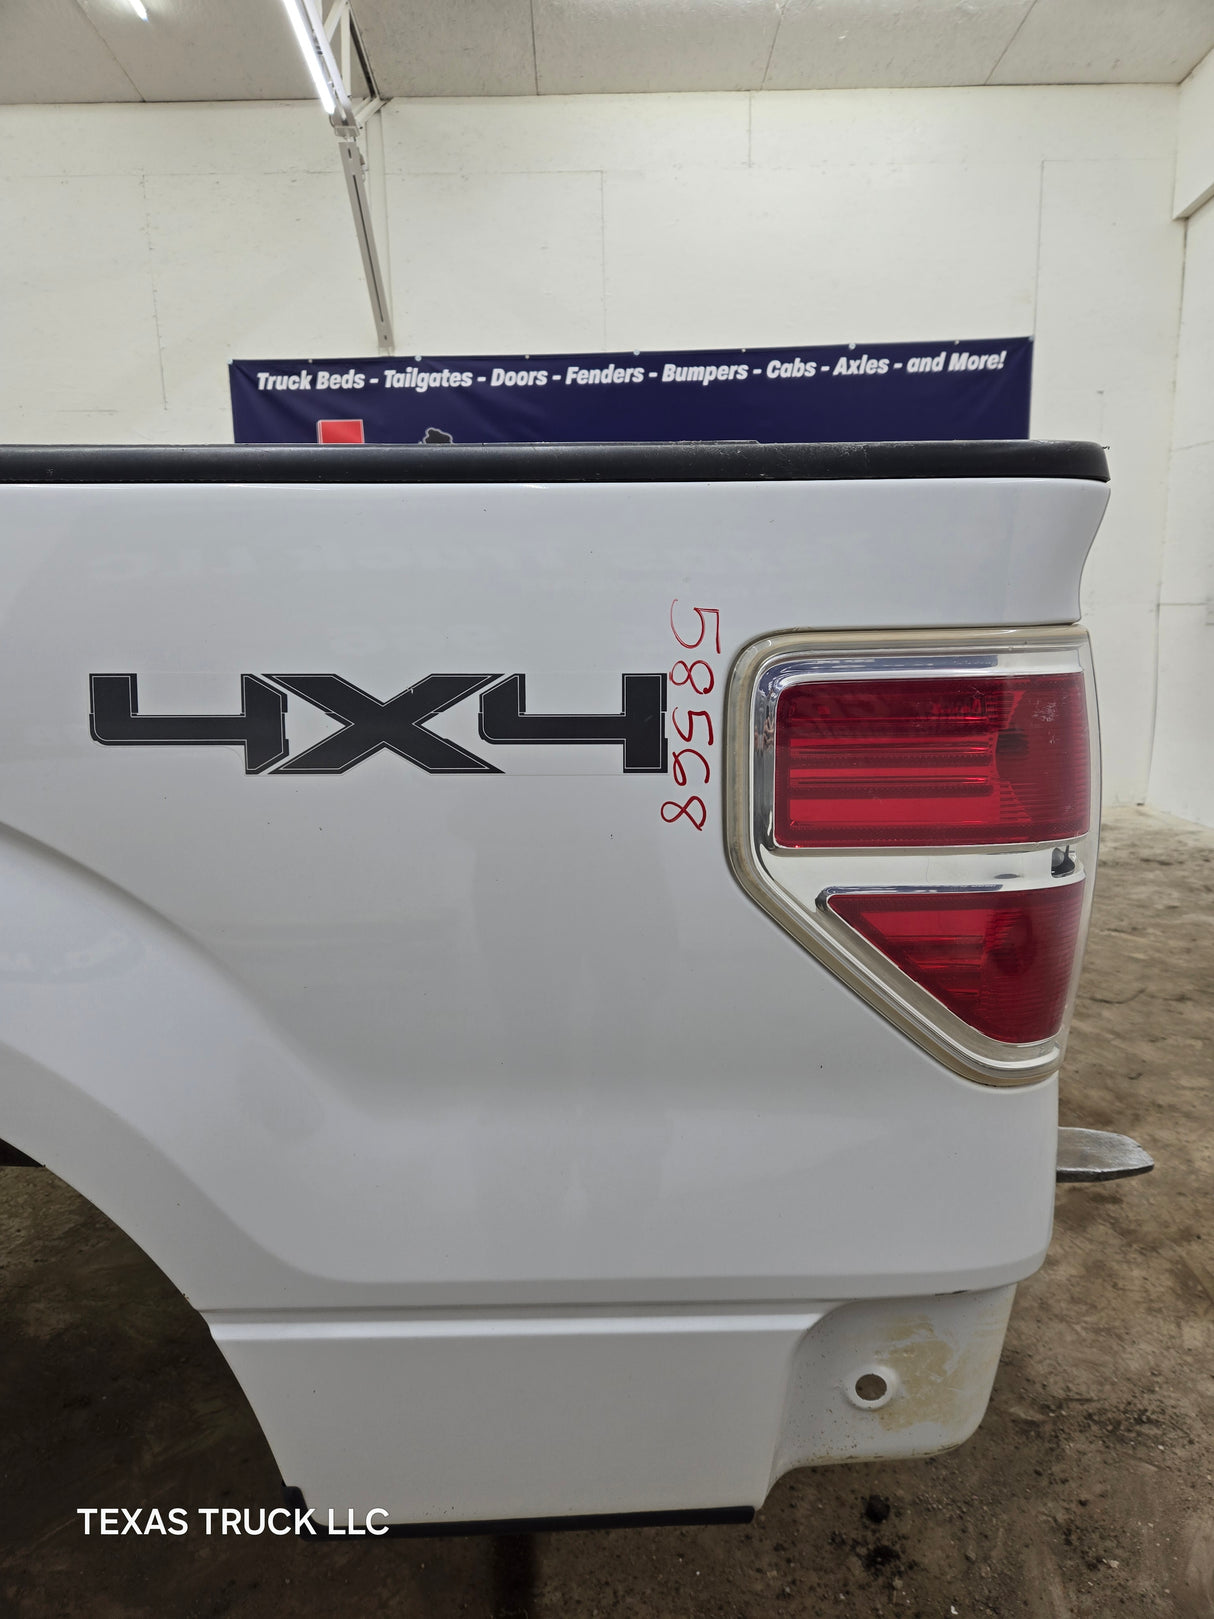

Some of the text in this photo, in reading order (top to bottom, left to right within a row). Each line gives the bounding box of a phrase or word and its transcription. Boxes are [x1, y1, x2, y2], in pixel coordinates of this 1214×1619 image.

[256, 370, 312, 391] Truck
[315, 368, 366, 390] Beds
[383, 366, 473, 393] Tailgates
[490, 367, 549, 387] Doors
[565, 364, 645, 385] Fenders
[661, 363, 749, 386] Bumpers
[766, 358, 817, 379] Cabs
[833, 354, 890, 376] Axles
[906, 351, 947, 373] and
[947, 350, 1007, 372] More!
[89, 673, 668, 774] 4X4
[660, 598, 722, 832] 58568
